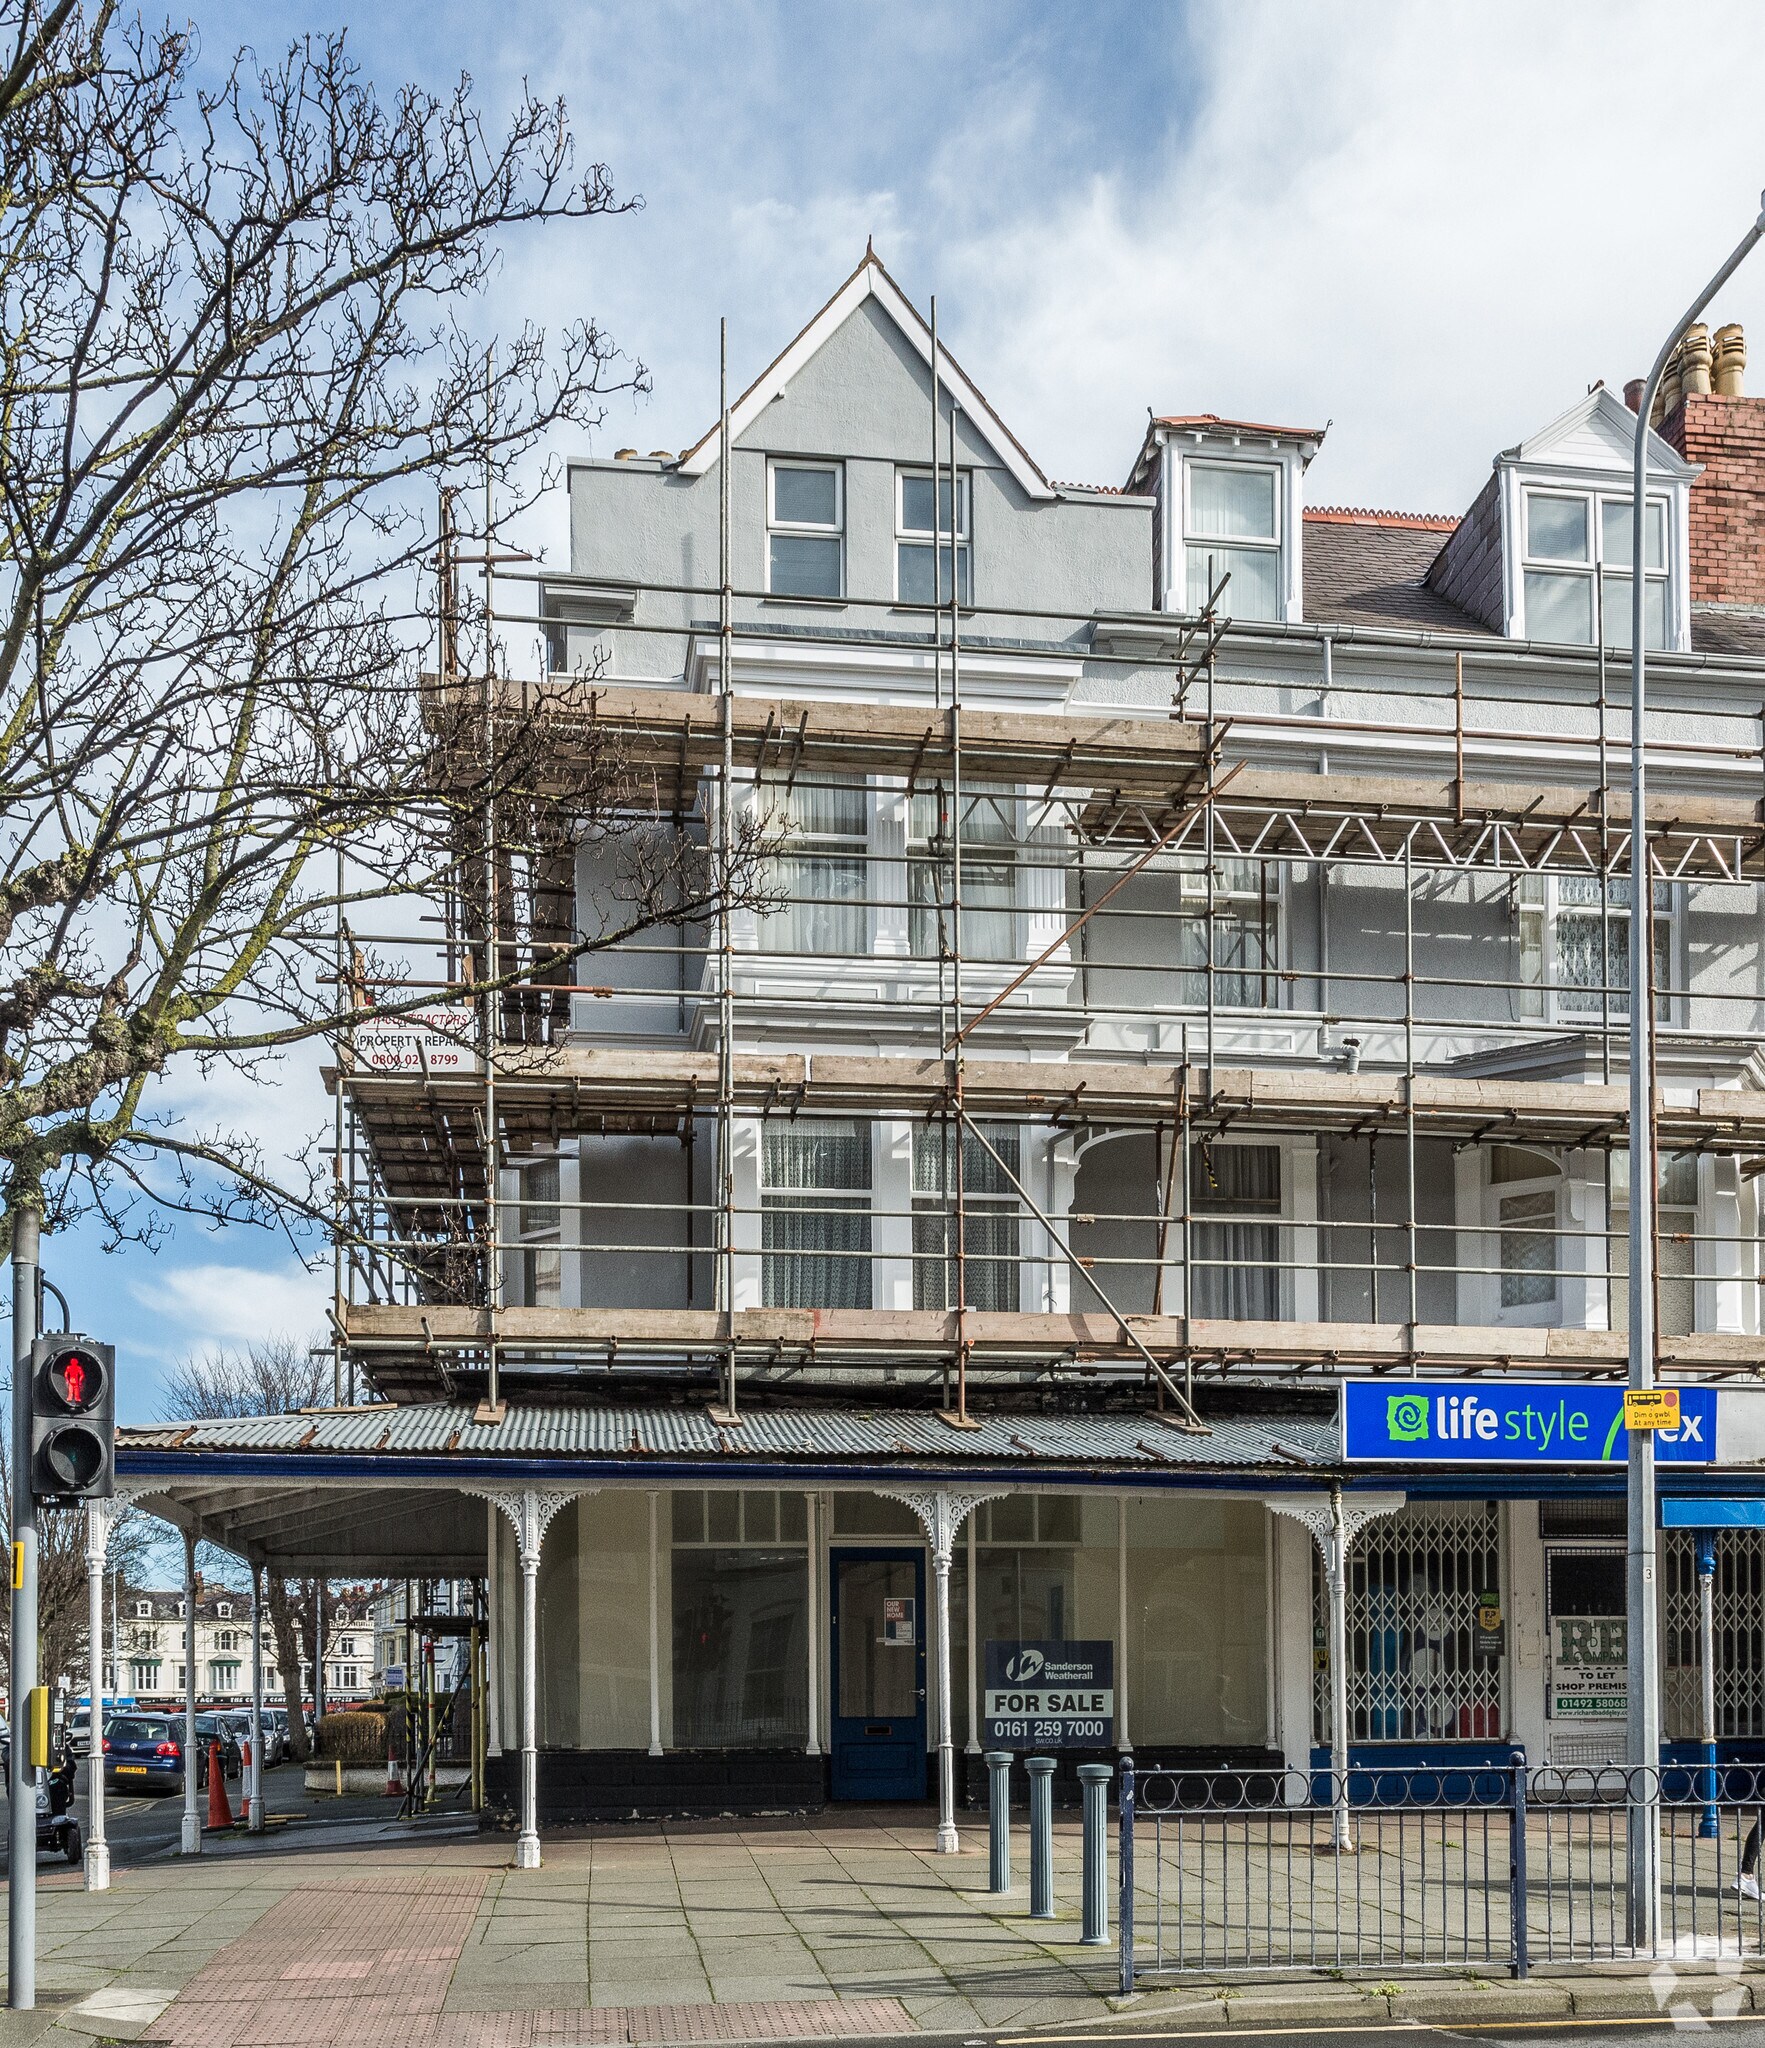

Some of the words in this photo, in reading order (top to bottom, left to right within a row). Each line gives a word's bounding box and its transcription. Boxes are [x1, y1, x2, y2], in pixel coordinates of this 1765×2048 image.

[359, 1035, 420, 1047] PROPERTY
[424, 1035, 463, 1047] REPA
[371, 1054, 401, 1065] 0800
[430, 1054, 459, 1065] 8799
[1645, 1568, 1652, 1580] 3
[1561, 1637, 1627, 1648] BADDELE
[1573, 1651, 1627, 1662] COMPAN
[1044, 1661, 1093, 1671] Sanderson
[1044, 1671, 1093, 1680] Weatherall
[1579, 1672, 1594, 1680] TO
[1597, 1672, 1616, 1680] LET
[1556, 1683, 1585, 1691] SHOP
[1588, 1682, 1627, 1691] PREMIS
[994, 1694, 1040, 1713] FOR
[1047, 1694, 1104, 1713] SALE
[1561, 1699, 1593, 1708] 01492
[1595, 1699, 1627, 1708] 58068
[994, 1721, 1028, 1737] 0161
[1034, 1721, 1062, 1737] 259
[1066, 1721, 1104, 1737] 7000
